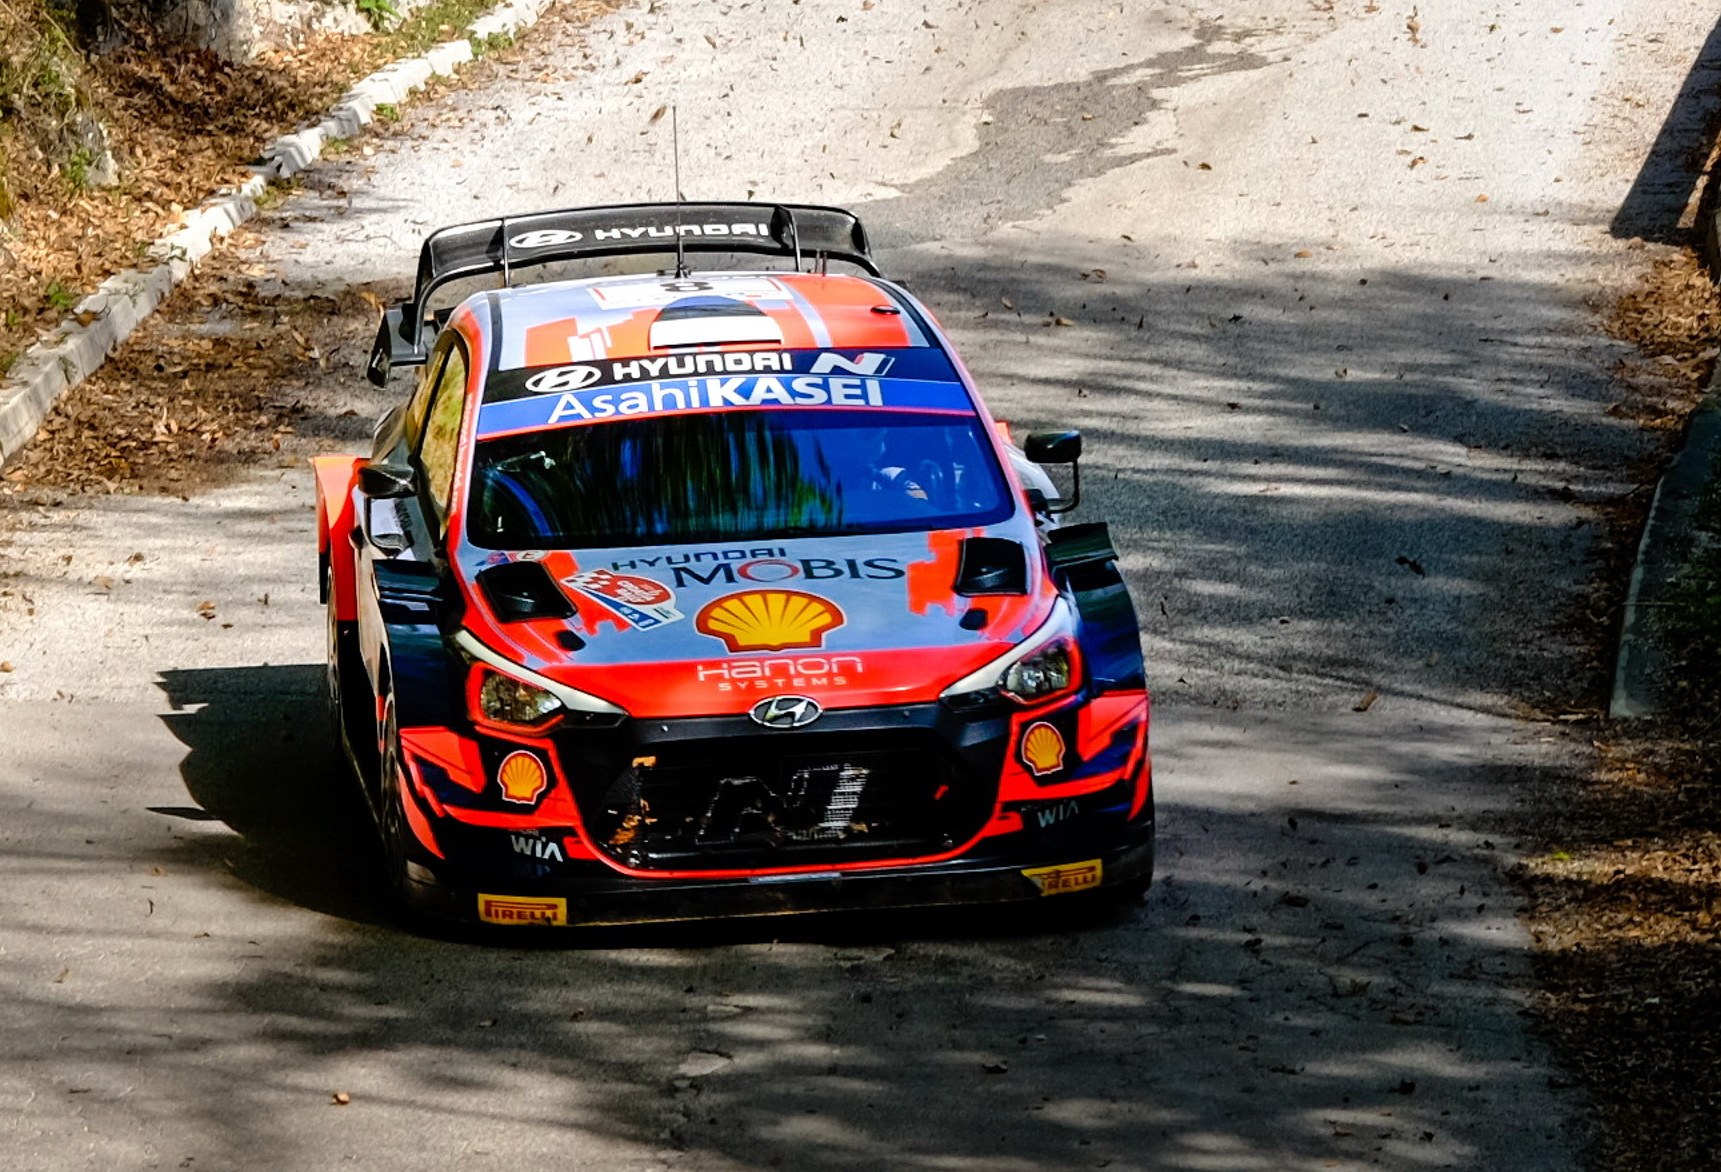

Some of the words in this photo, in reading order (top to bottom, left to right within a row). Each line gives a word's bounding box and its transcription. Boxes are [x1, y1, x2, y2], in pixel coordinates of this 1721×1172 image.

[594, 222, 769, 241] HYUNDAI
[613, 352, 793, 381] HYUNDAI
[611, 547, 788, 571] HYUNDAI
[670, 558, 906, 588] MOBIS
[718, 676, 848, 692] SYSTEMS
[483, 900, 559, 921] PIRELLI
